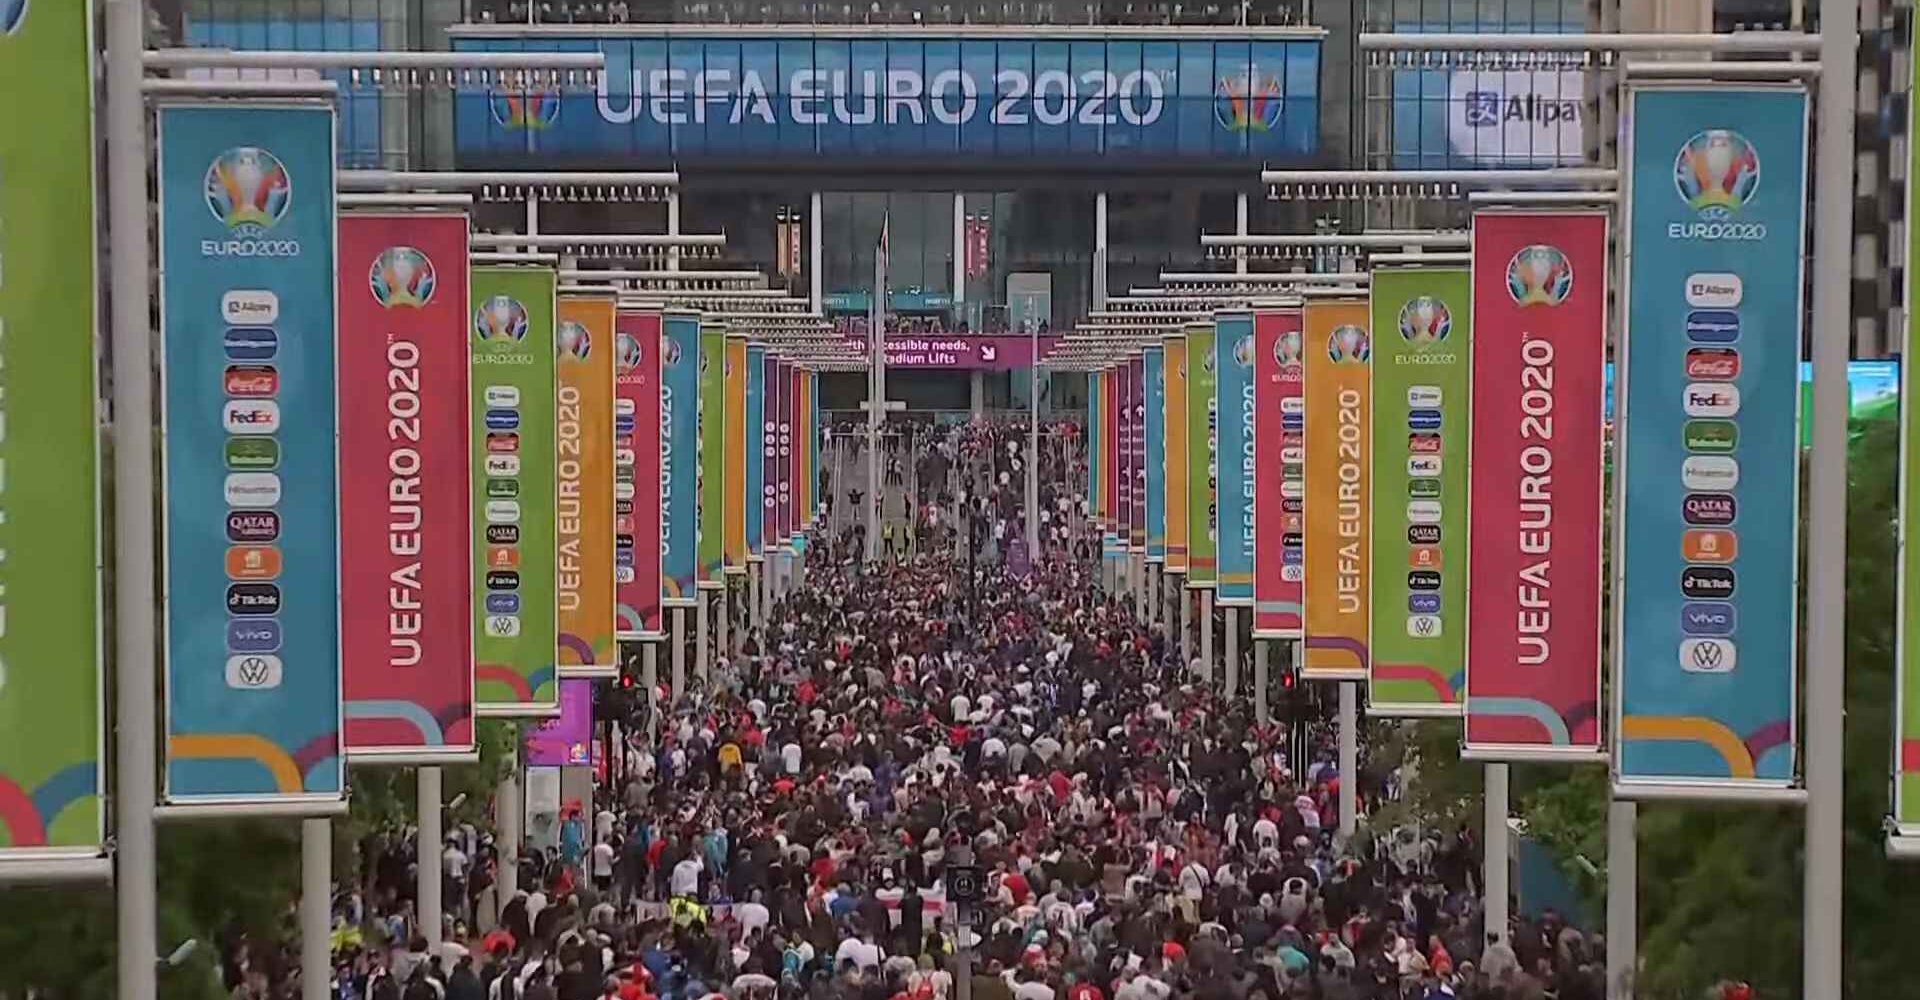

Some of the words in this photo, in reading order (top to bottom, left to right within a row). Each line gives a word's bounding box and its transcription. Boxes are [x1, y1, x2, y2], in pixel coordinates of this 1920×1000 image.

[597, 69, 776, 124] UEFA
[790, 69, 977, 124] EURO
[928, 353, 956, 364] Lifts
[932, 340, 970, 352] needs,
[229, 409, 274, 424] FedEx
[1689, 392, 1733, 407] FedEx
[229, 516, 275, 529] QATAR
[389, 448, 422, 555] EURO
[558, 460, 581, 535] EURO
[1338, 463, 1361, 537] EURO
[1519, 446, 1553, 554] EURO
[1687, 499, 1732, 513] QATAR
[241, 594, 277, 606] TikTok
[558, 539, 581, 611] UEFA
[1338, 542, 1361, 614] UEFA
[388, 562, 422, 666] UEFA
[1517, 560, 1551, 665] UEFA
